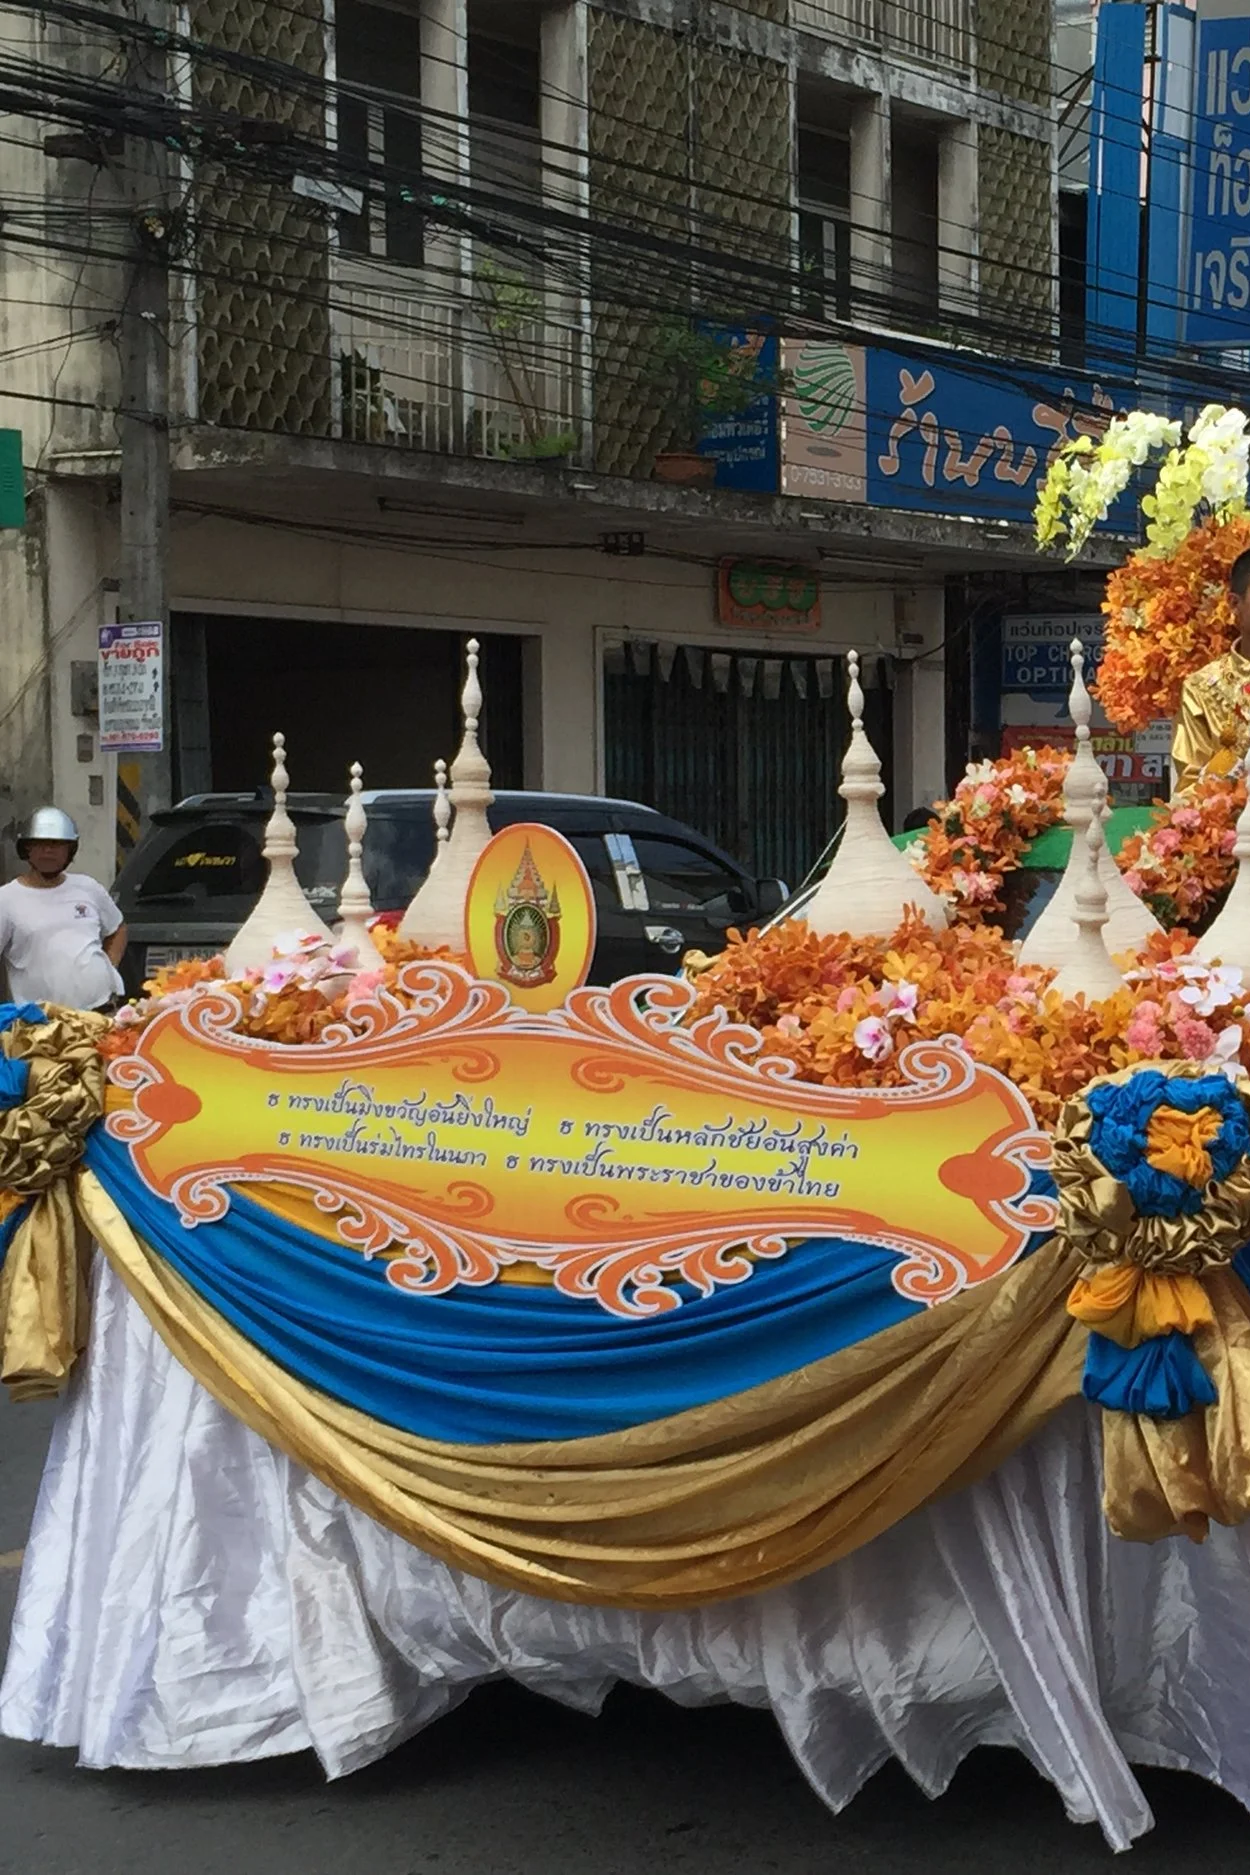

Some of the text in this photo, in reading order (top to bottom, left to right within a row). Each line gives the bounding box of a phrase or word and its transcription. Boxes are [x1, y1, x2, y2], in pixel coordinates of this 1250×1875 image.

[1006, 645, 1038, 662] TOP
[288, 1079, 532, 1136] ทรงเป็นมิ่งขวัญอันยิ่งใหญ่
[584, 1105, 859, 1160] ทรงเป็นหลักชัยอันสูงค่า
[300, 1119, 487, 1167] ทรงเป็นร่มไทรในนภา
[530, 1141, 840, 1198] ทรงเป็นพระราชาของข้าไทย
